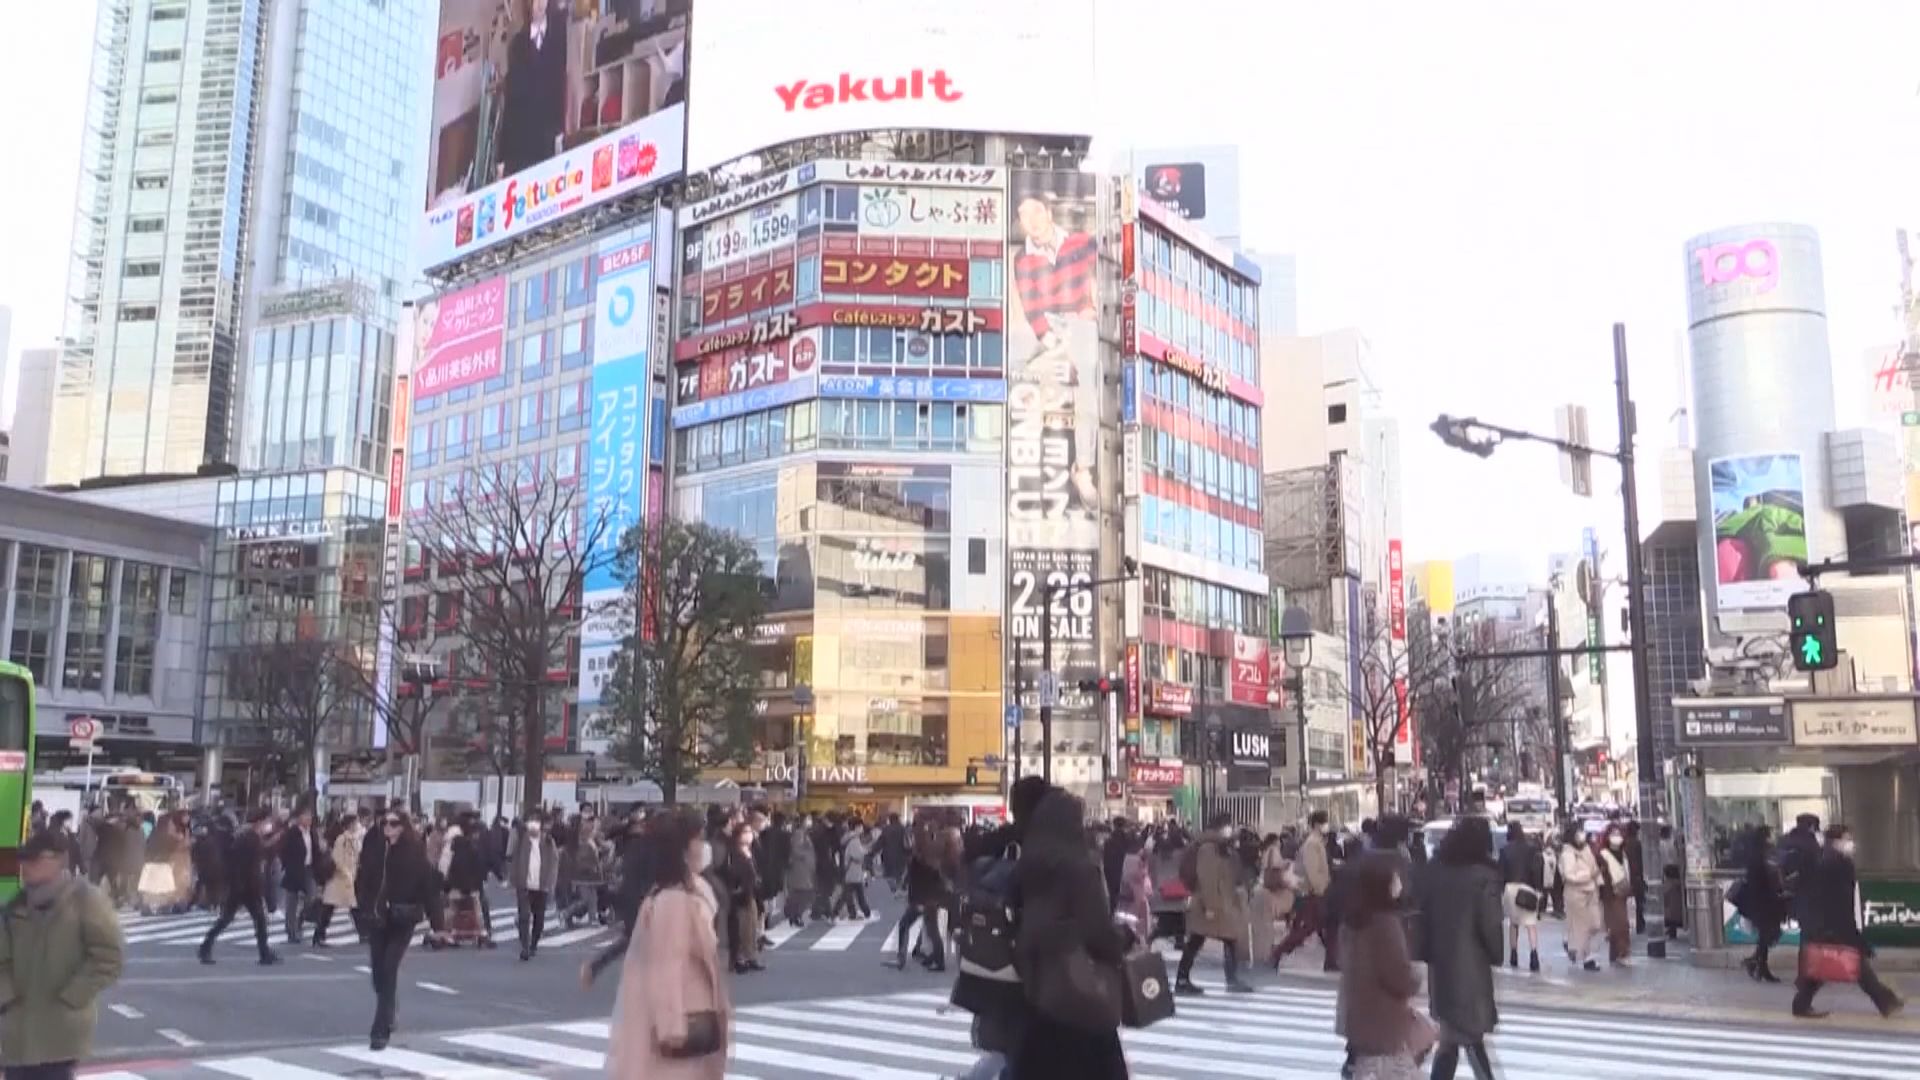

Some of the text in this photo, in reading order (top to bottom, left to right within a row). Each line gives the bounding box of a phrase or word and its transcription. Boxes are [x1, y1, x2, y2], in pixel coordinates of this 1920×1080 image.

[774, 68, 964, 112] Yakult
[845, 162, 997, 185] しゃぶしゃぶバイキング
[909, 196, 998, 226] しゃぶ葉
[686, 242, 702, 260] 9F
[823, 259, 963, 289] コンタクト
[1695, 239, 1779, 295] 109
[704, 268, 792, 317] プライス
[752, 311, 798, 345] ガスト
[920, 306, 987, 333] ガスト
[680, 374, 699, 397] 7F
[729, 352, 785, 392] ガスト
[226, 519, 332, 540] MARK CITY
[1012, 570, 1093, 616] 2.26
[1012, 616, 1093, 640] ON SALE
[1238, 663, 1262, 683] アコム
[1233, 732, 1269, 758] LUSH
